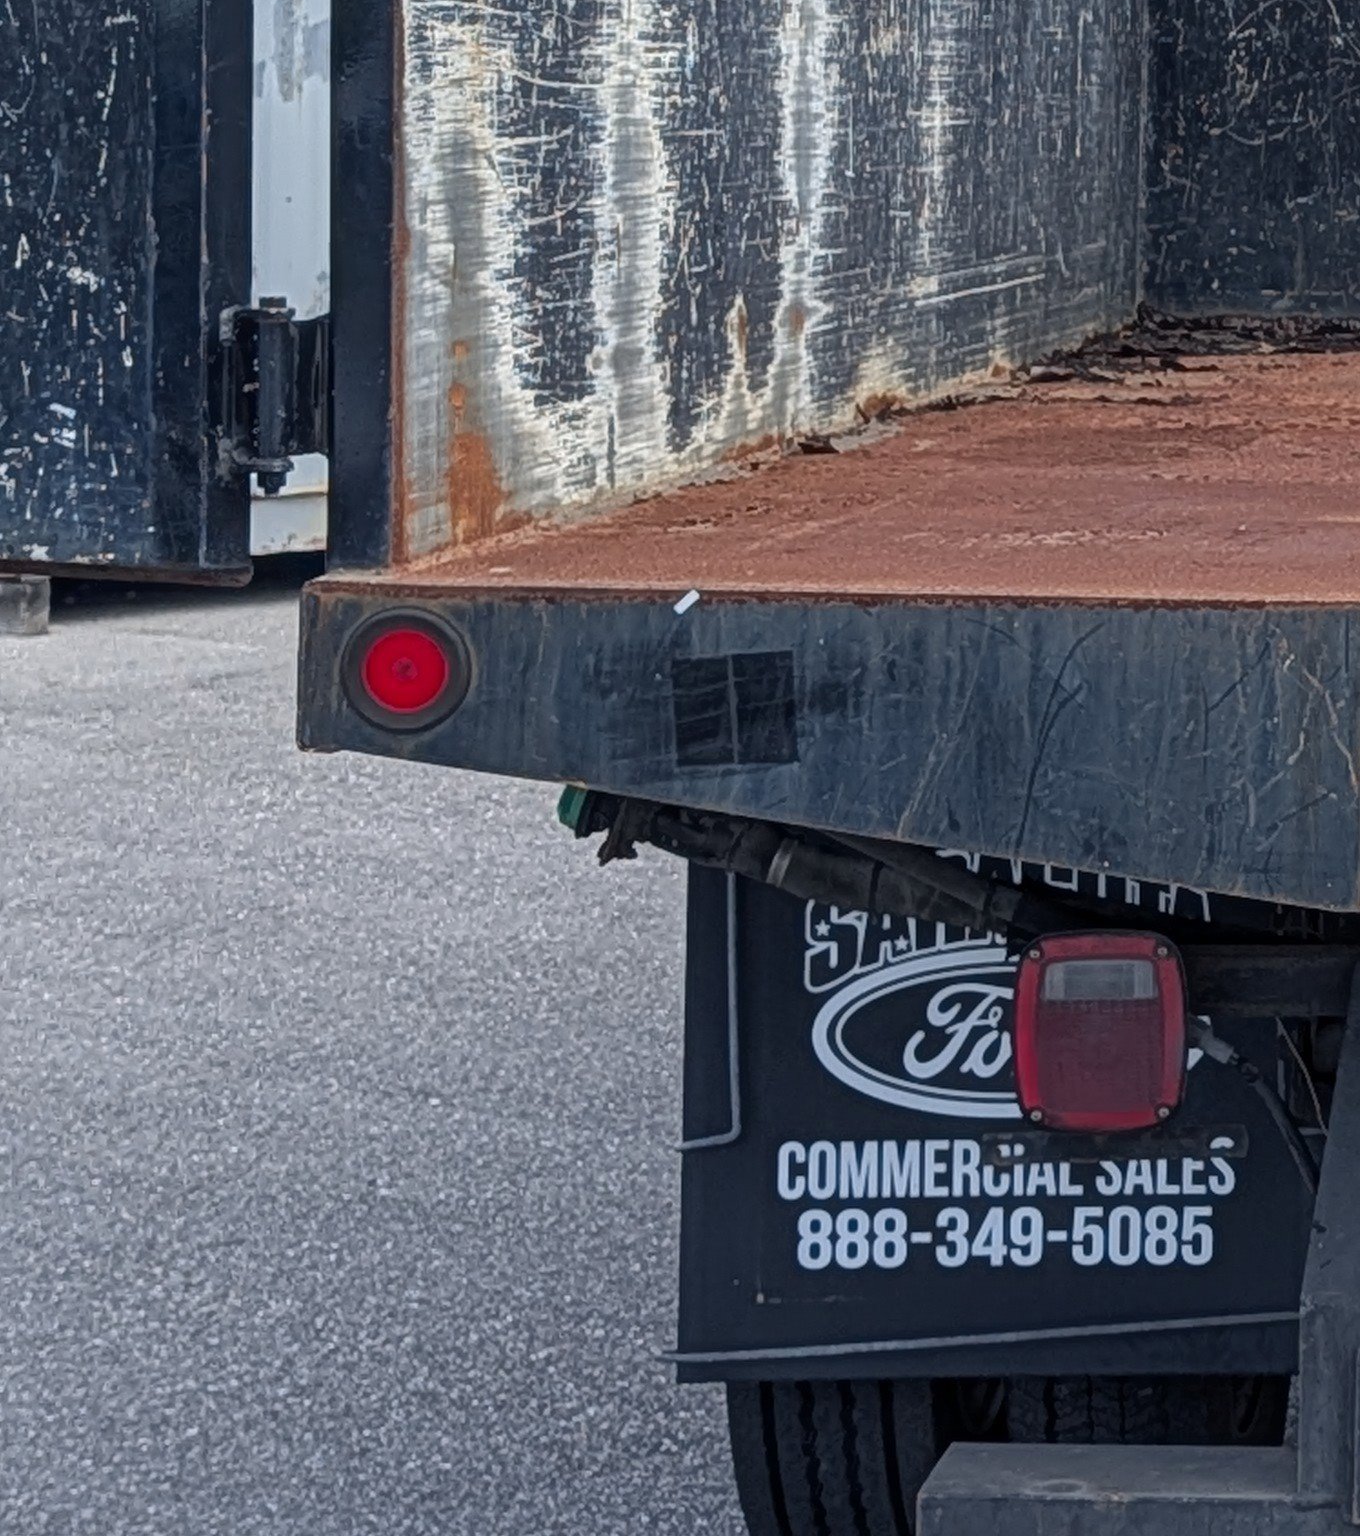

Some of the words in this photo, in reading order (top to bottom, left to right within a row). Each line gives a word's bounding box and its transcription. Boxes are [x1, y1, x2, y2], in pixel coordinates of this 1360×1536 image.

[903, 982, 1015, 1079] Fo
[1095, 1137, 1236, 1196] SALES
[797, 1205, 1214, 1269] 888-349-5085
